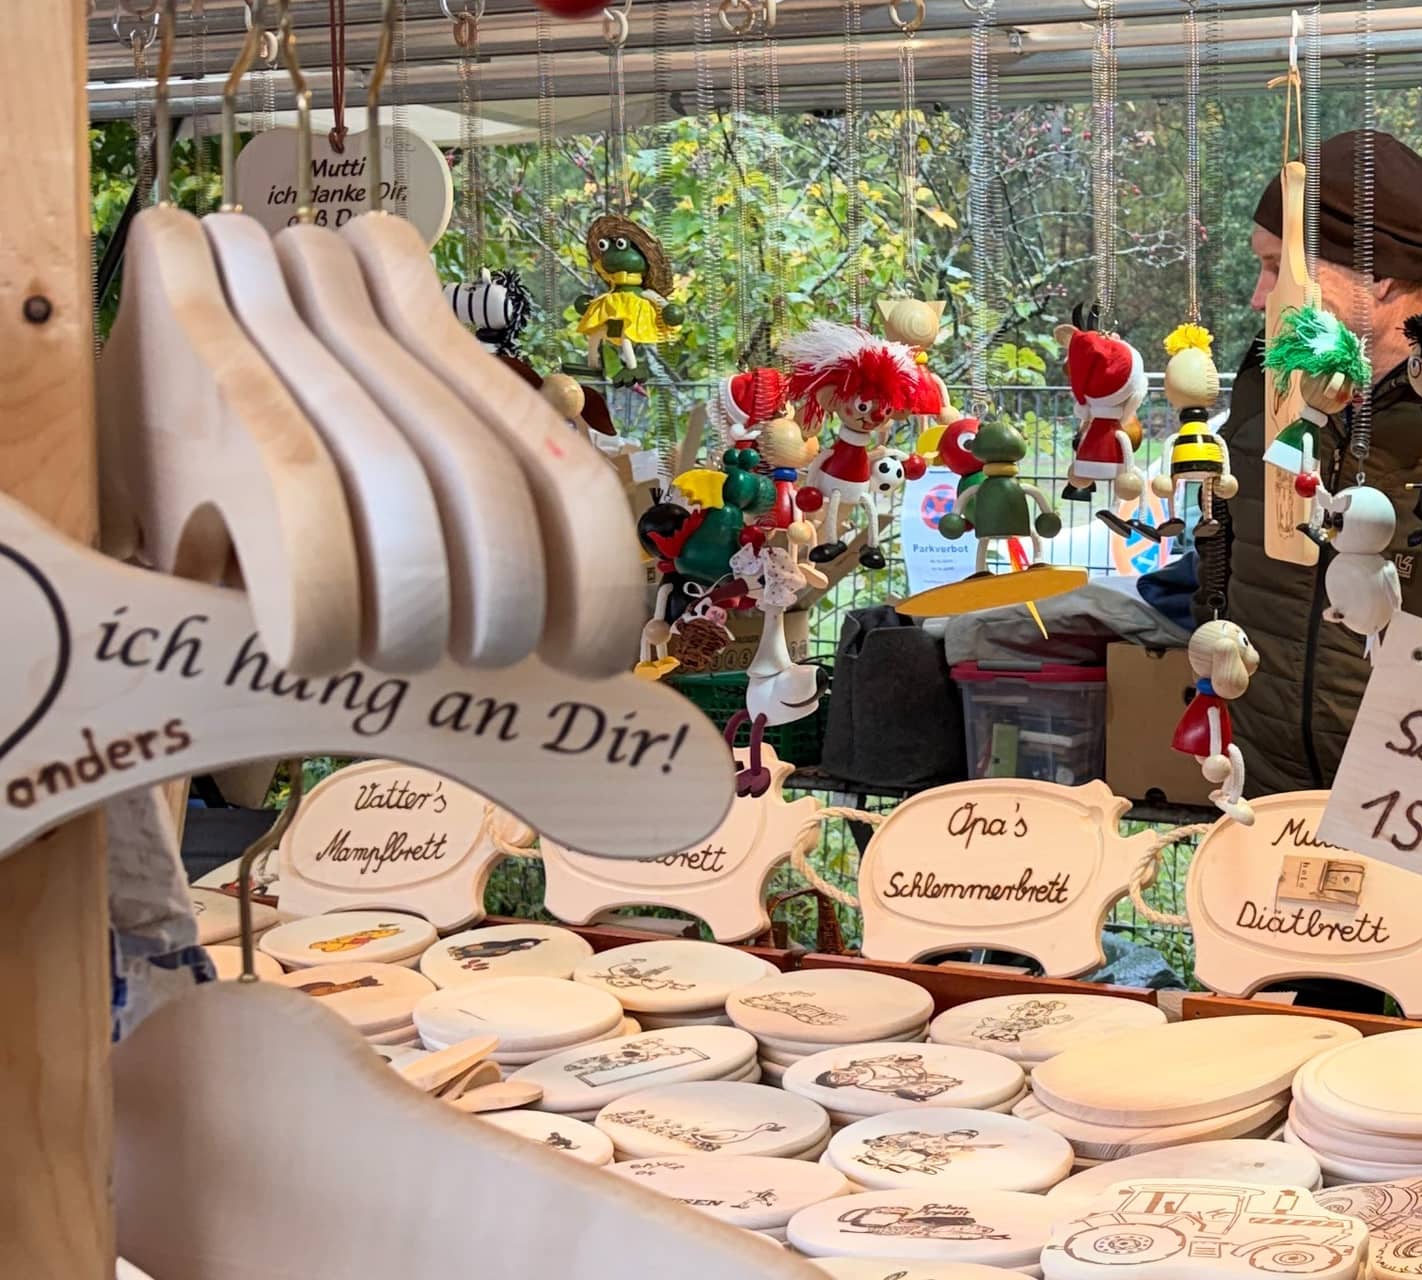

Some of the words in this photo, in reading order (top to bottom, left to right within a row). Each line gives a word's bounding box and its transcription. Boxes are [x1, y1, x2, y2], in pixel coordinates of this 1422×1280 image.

[310, 157, 367, 178] Mutti
[267, 185, 298, 205] ich
[95, 606, 209, 678] ich
[427, 690, 519, 741] an
[541, 701, 690, 774] Dir!
[6, 718, 192, 809] anders
[948, 802, 1028, 849] Opa's
[315, 828, 448, 875] Mampfbrett
[883, 868, 1070, 904] Schlemmerbrett
[1236, 901, 1391, 944] Diätbrett
